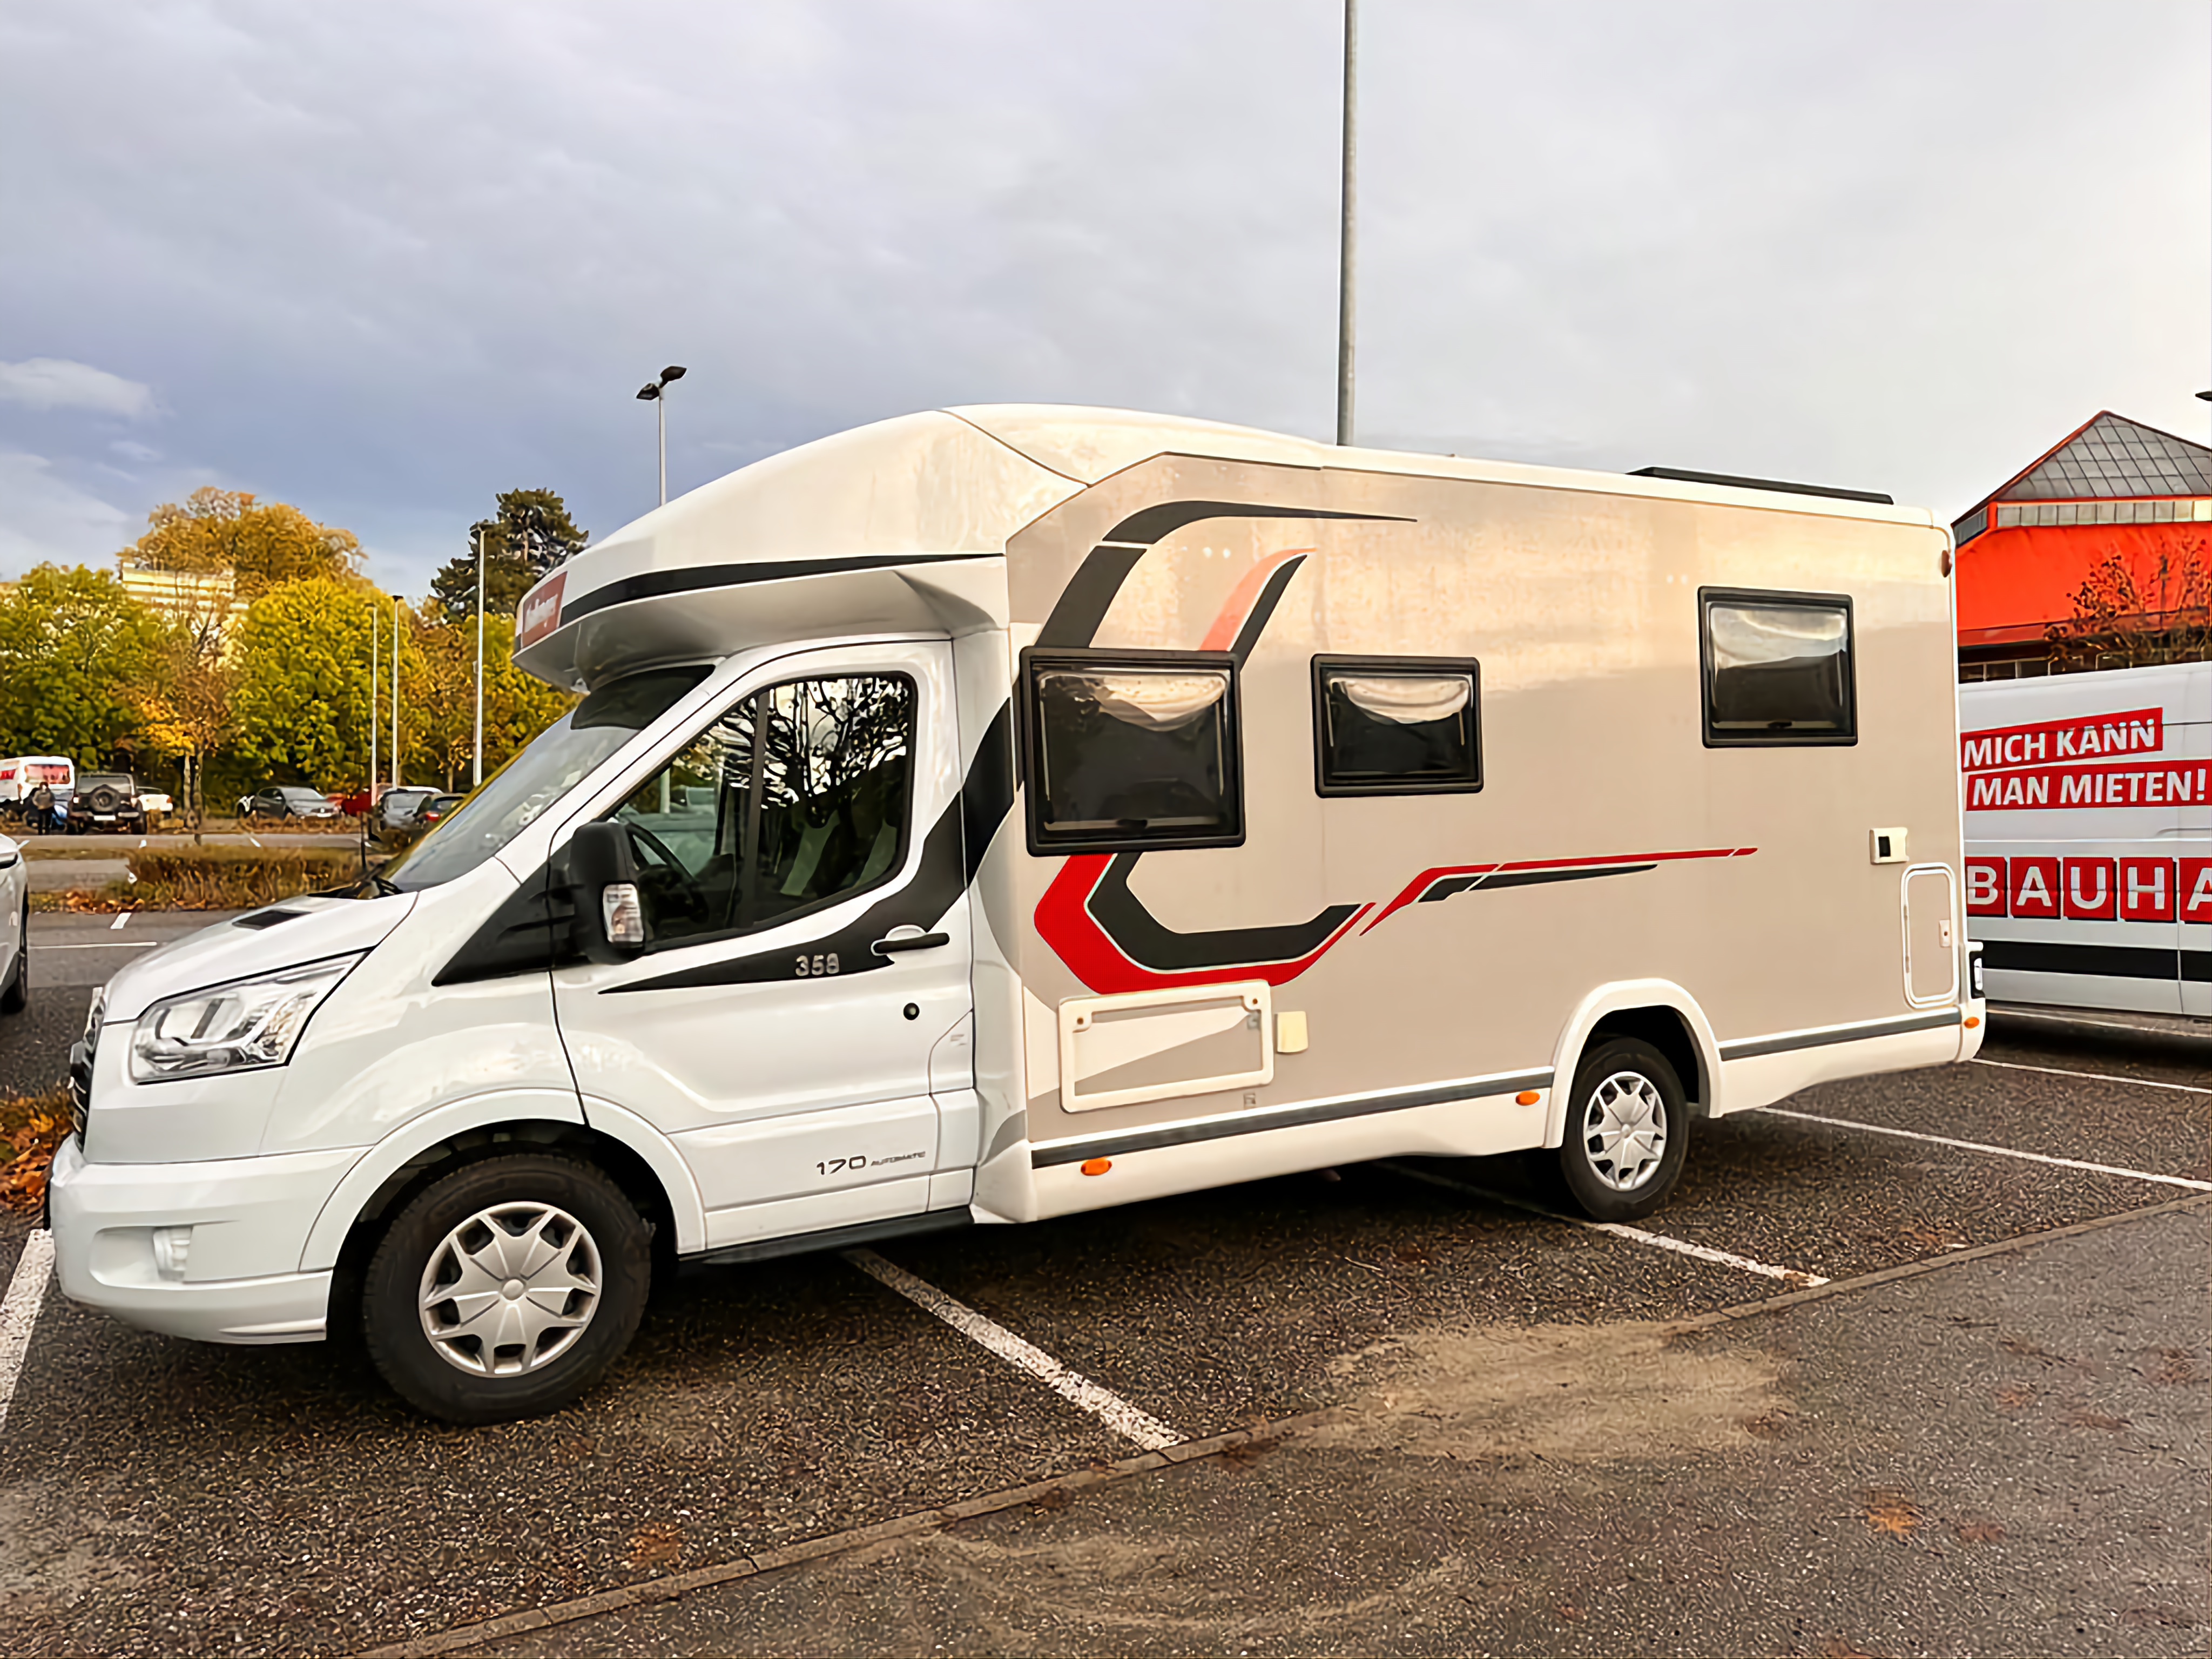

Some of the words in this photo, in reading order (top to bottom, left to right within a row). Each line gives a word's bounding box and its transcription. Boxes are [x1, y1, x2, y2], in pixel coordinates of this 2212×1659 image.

[1964, 732, 2046, 768] MICH
[2056, 719, 2155, 757] KANN
[1973, 776, 2049, 806] MAN
[2060, 768, 2206, 804] MIETEN!
[817, 1155, 866, 1175] 170
